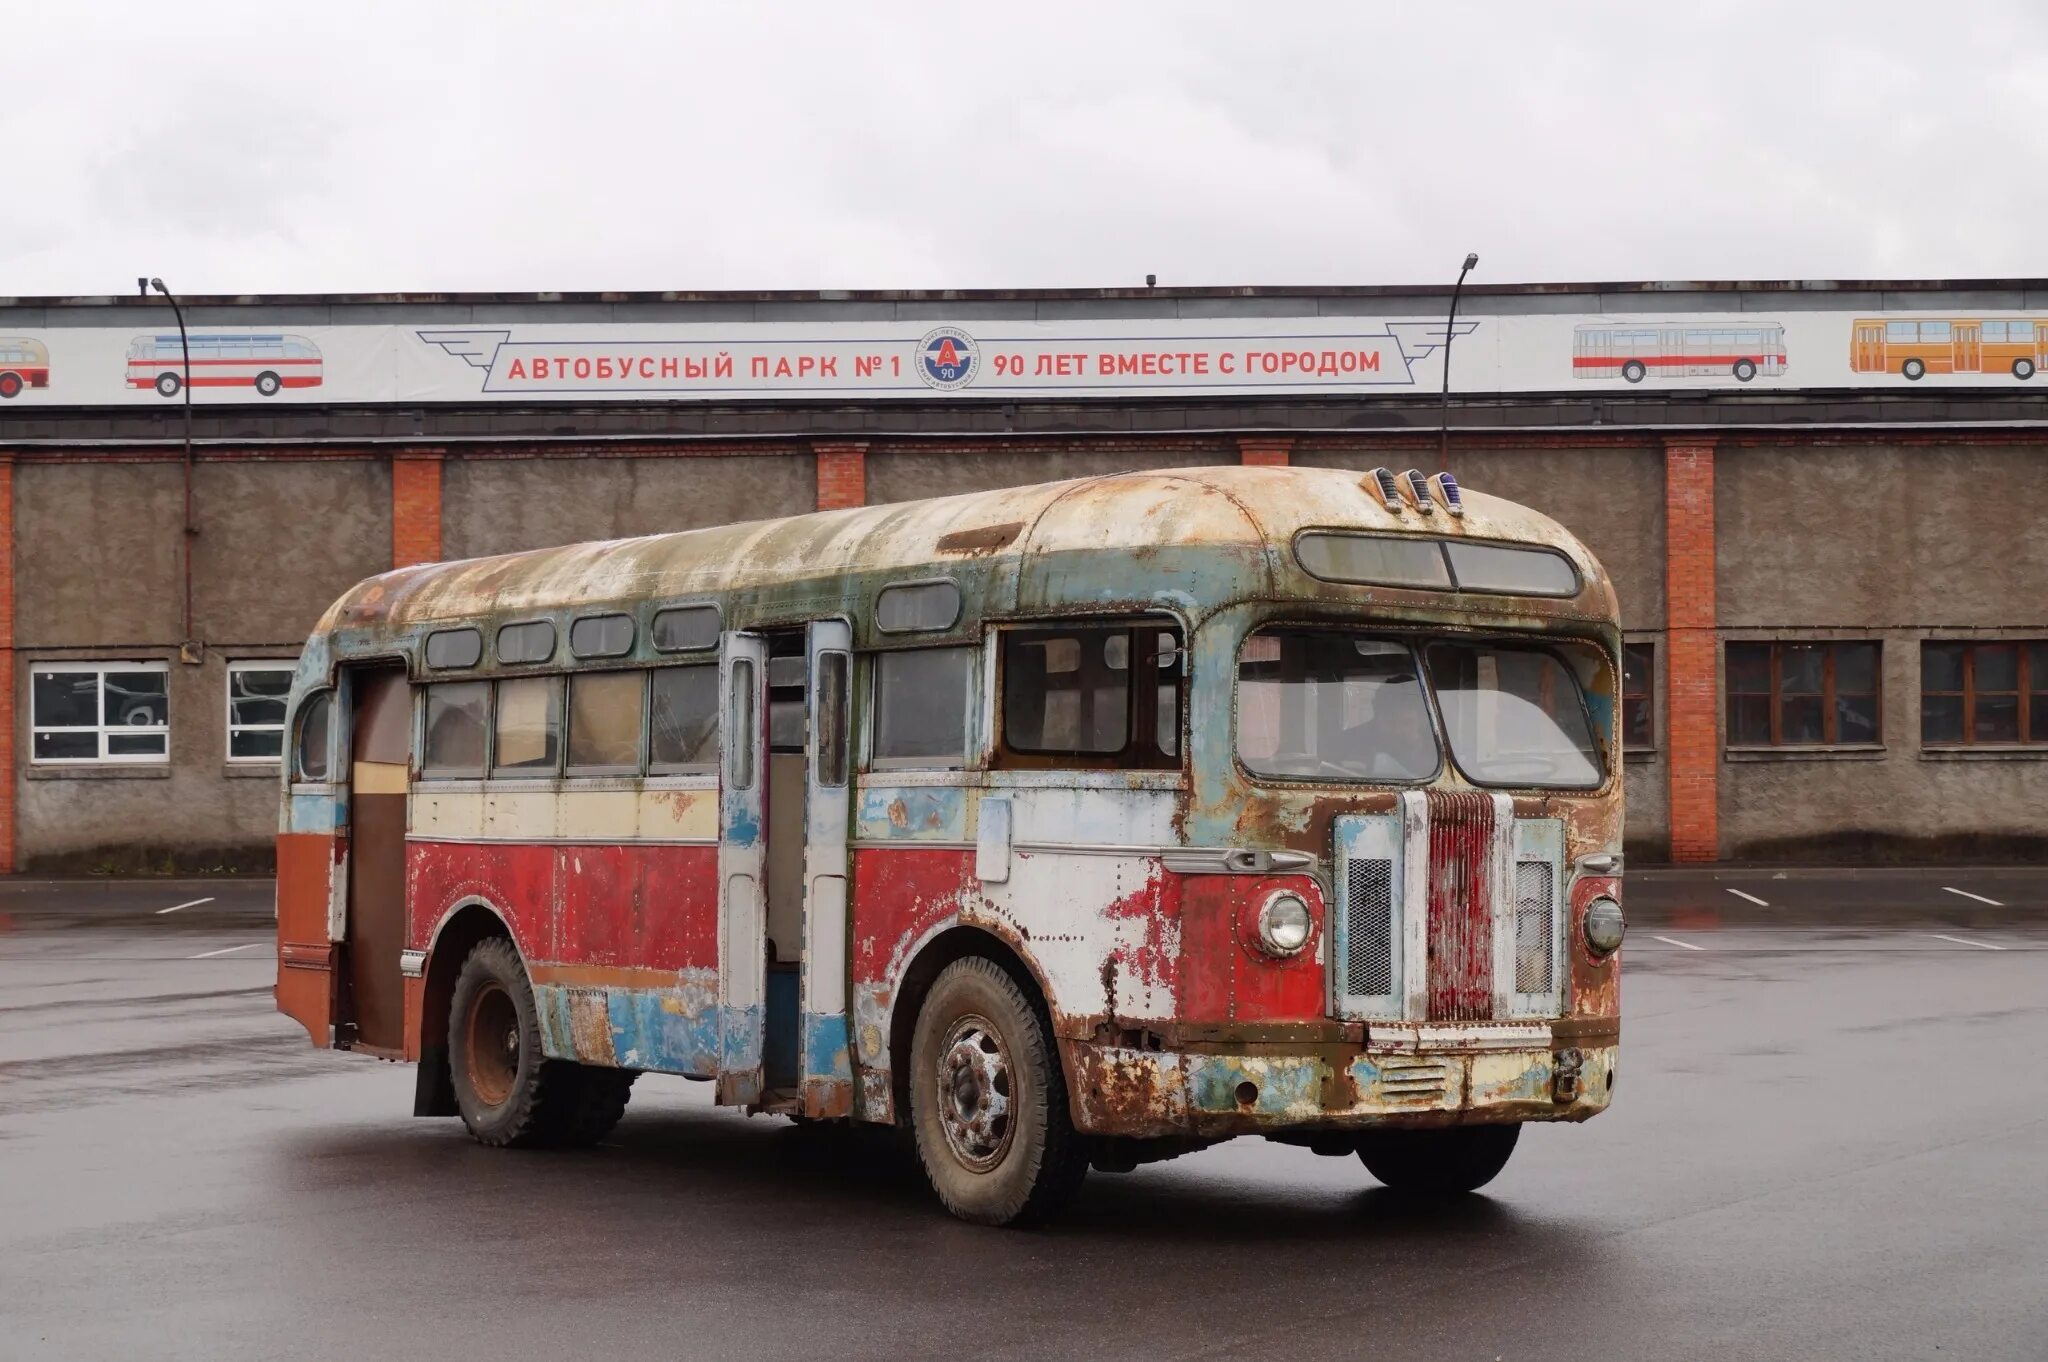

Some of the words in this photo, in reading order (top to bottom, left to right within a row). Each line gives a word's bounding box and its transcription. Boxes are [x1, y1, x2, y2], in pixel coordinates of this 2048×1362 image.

[507, 351, 734, 381] АВТОБУСНЫЙ
[750, 355, 838, 378] ПАРК
[853, 354, 901, 377] №1
[940, 368, 955, 379] 90
[992, 352, 1026, 377] 90
[1034, 352, 1089, 377] ЛЕТ
[1097, 351, 1210, 377] ВМЕСТЕ
[1217, 351, 1235, 375] С
[1244, 350, 1381, 377] ГОРОДОМ
